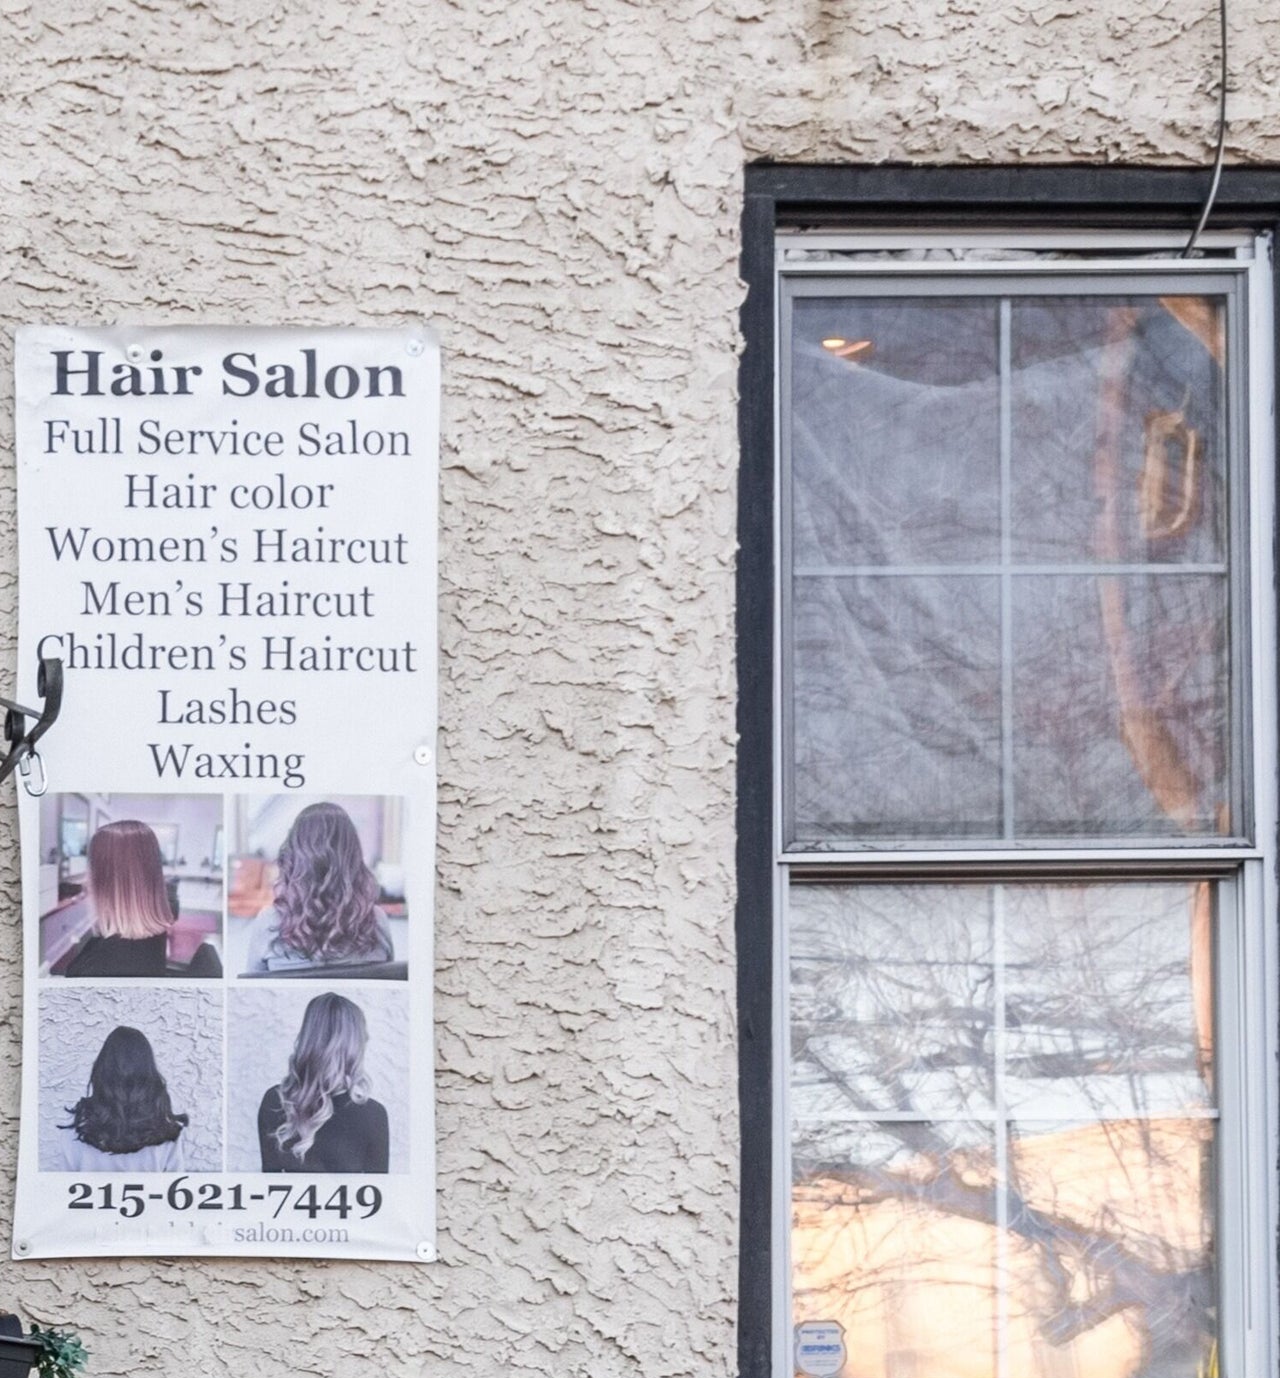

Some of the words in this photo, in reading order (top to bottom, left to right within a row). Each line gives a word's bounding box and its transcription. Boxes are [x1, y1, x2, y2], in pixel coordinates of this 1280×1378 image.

[50, 349, 202, 397] Hair
[222, 349, 406, 399] Salon
[43, 418, 122, 454] Full
[138, 419, 284, 456] Service
[298, 419, 411, 457] Salon
[124, 473, 216, 509] Hair
[230, 474, 334, 509] color
[46, 526, 238, 562] Women’s
[253, 527, 409, 564] Haircut
[80, 580, 204, 616] Men’s
[218, 580, 375, 617] Haircut
[37, 632, 247, 671] Children’s
[262, 635, 418, 672] Haircut
[157, 688, 297, 725] Lashes
[148, 743, 306, 788] Waxing
[68, 1176, 383, 1219] 215-621-7449
